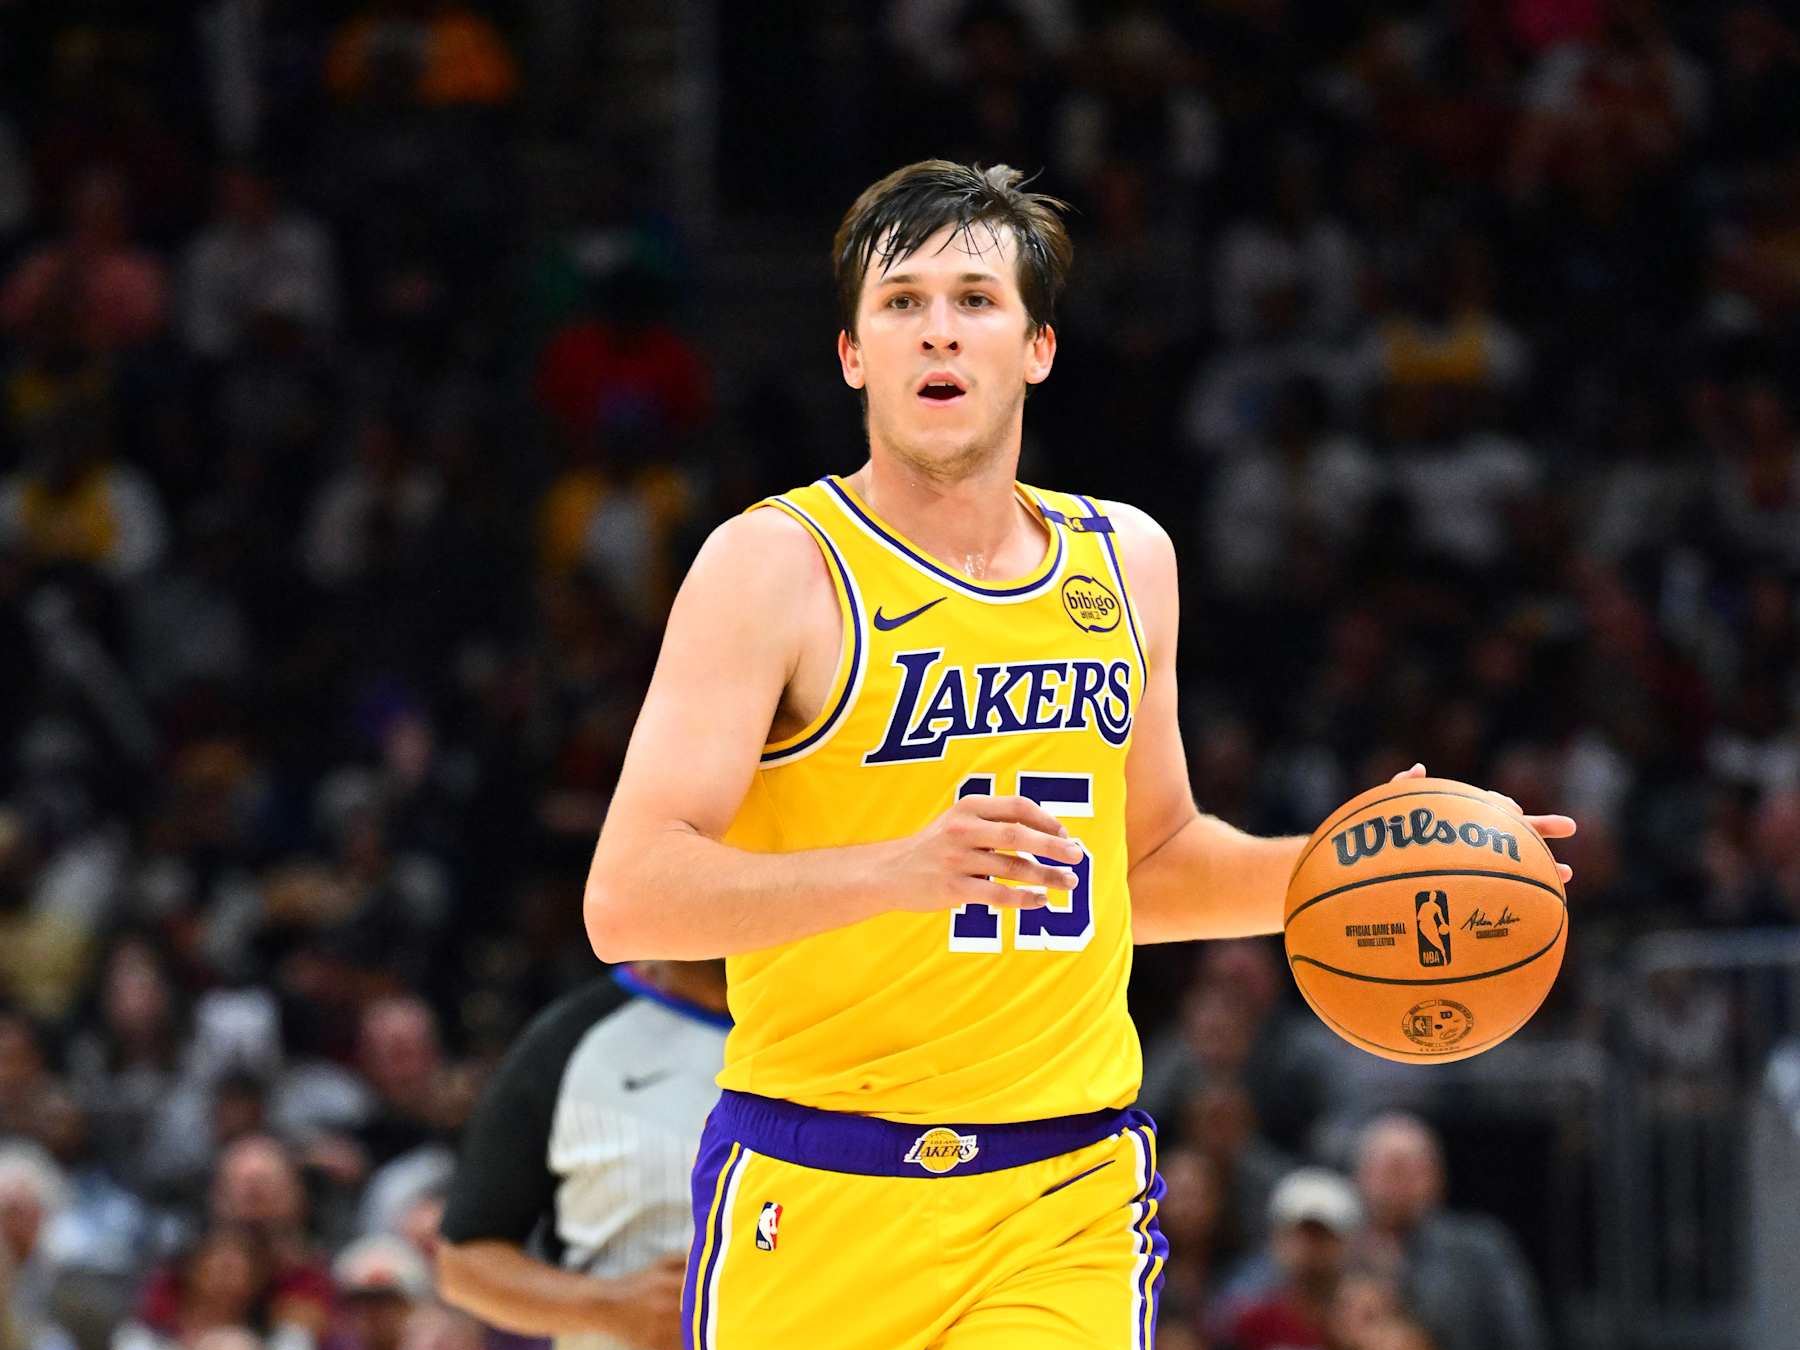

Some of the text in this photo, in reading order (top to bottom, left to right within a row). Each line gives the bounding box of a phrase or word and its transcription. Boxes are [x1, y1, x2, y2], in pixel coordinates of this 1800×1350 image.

[1066, 590, 1115, 616] bibigo
[862, 648, 1132, 766] LAKERS
[1331, 807, 1521, 866] Wilson
[1422, 951, 1440, 964] NBA
[911, 1140, 973, 1161] LAKERS
